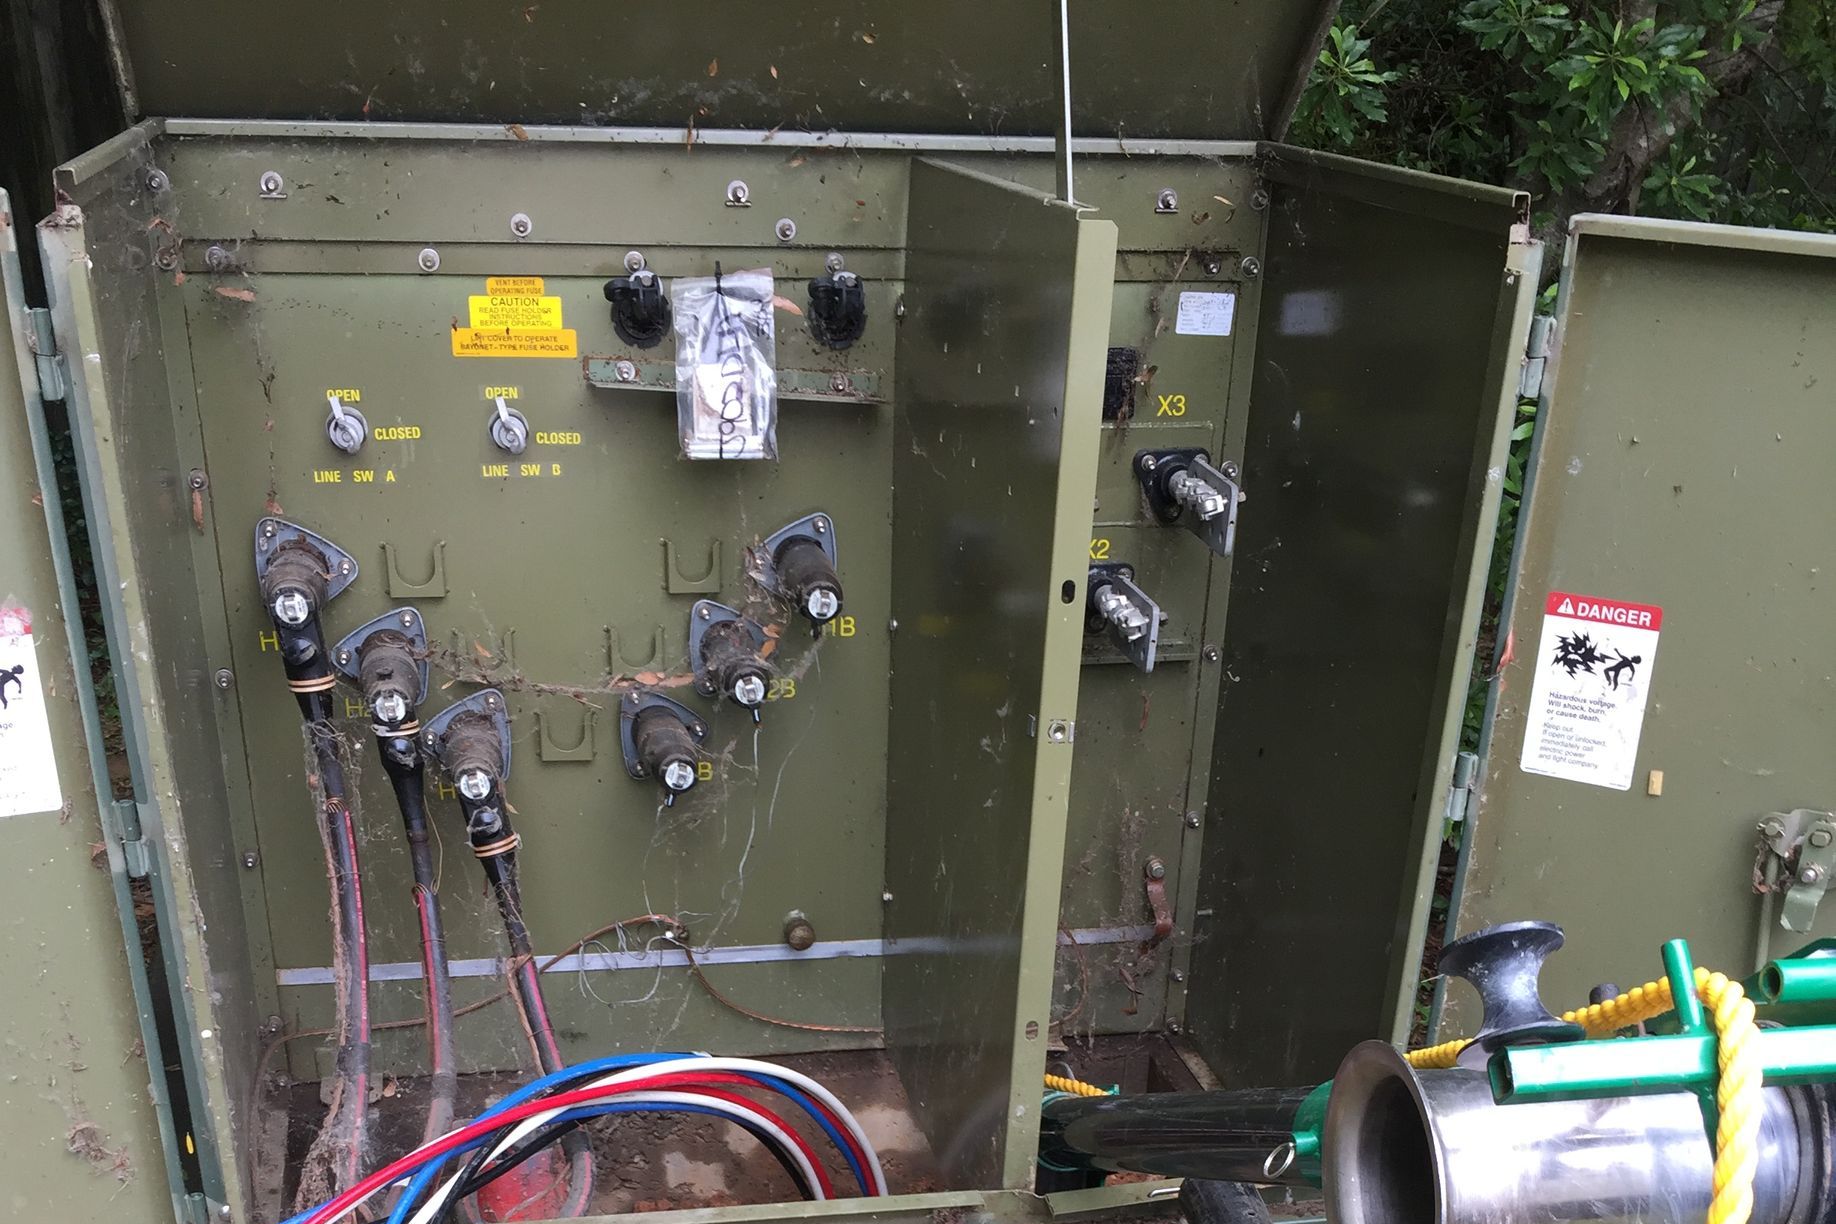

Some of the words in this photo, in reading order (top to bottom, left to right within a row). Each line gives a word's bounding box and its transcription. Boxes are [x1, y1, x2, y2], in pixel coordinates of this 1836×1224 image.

[490, 298, 539, 306] CAUTION
[488, 334, 512, 342] COVER
[326, 390, 361, 401] OPEN
[485, 387, 519, 399] OPEN
[1157, 395, 1186, 416] X3
[374, 427, 421, 441] CLOSED
[536, 432, 581, 445] CLOSED
[314, 471, 341, 483] LINE
[353, 470, 374, 482] SW
[386, 470, 396, 482] A
[482, 465, 509, 477] LINE
[520, 464, 540, 476] SW
[552, 464, 561, 476] B
[1089, 539, 1110, 559] X2
[1576, 602, 1652, 628] DANGER
[828, 616, 855, 637] 1B
[259, 631, 279, 652] H
[767, 678, 796, 699] 2B
[1549, 691, 1587, 703] Hazardous
[1556, 710, 1577, 718] cause
[1543, 722, 1561, 730] Keep
[1548, 731, 1565, 739] open
[1564, 750, 1585, 759] power
